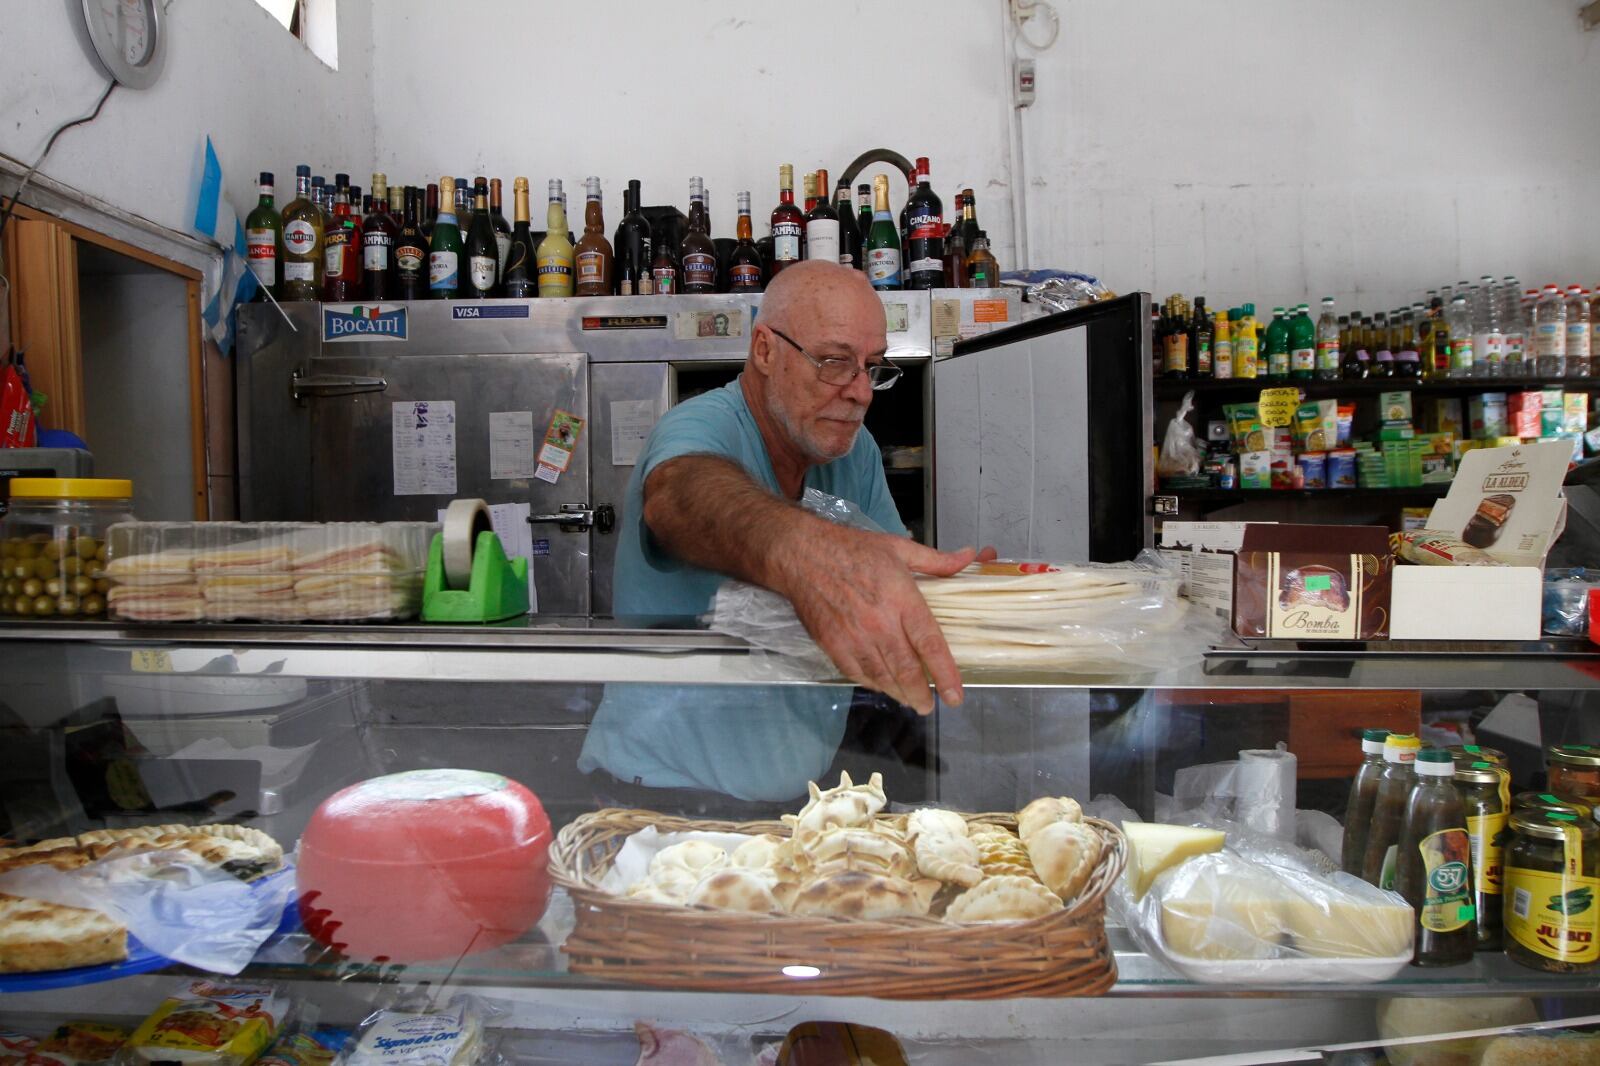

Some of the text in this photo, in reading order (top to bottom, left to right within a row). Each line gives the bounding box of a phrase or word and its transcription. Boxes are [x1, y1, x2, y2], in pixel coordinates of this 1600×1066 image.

[910, 214, 941, 225] CINZANO
[363, 234, 392, 245] AMPARI
[248, 246, 276, 256] ANCIA
[456, 308, 480, 317] VISA
[331, 315, 399, 335] BOCATTI
[607, 317, 660, 327] REAL
[1486, 476, 1526, 488] LA ALDEA
[1282, 610, 1340, 629] Bomba
[433, 1031, 460, 1041] Oro
